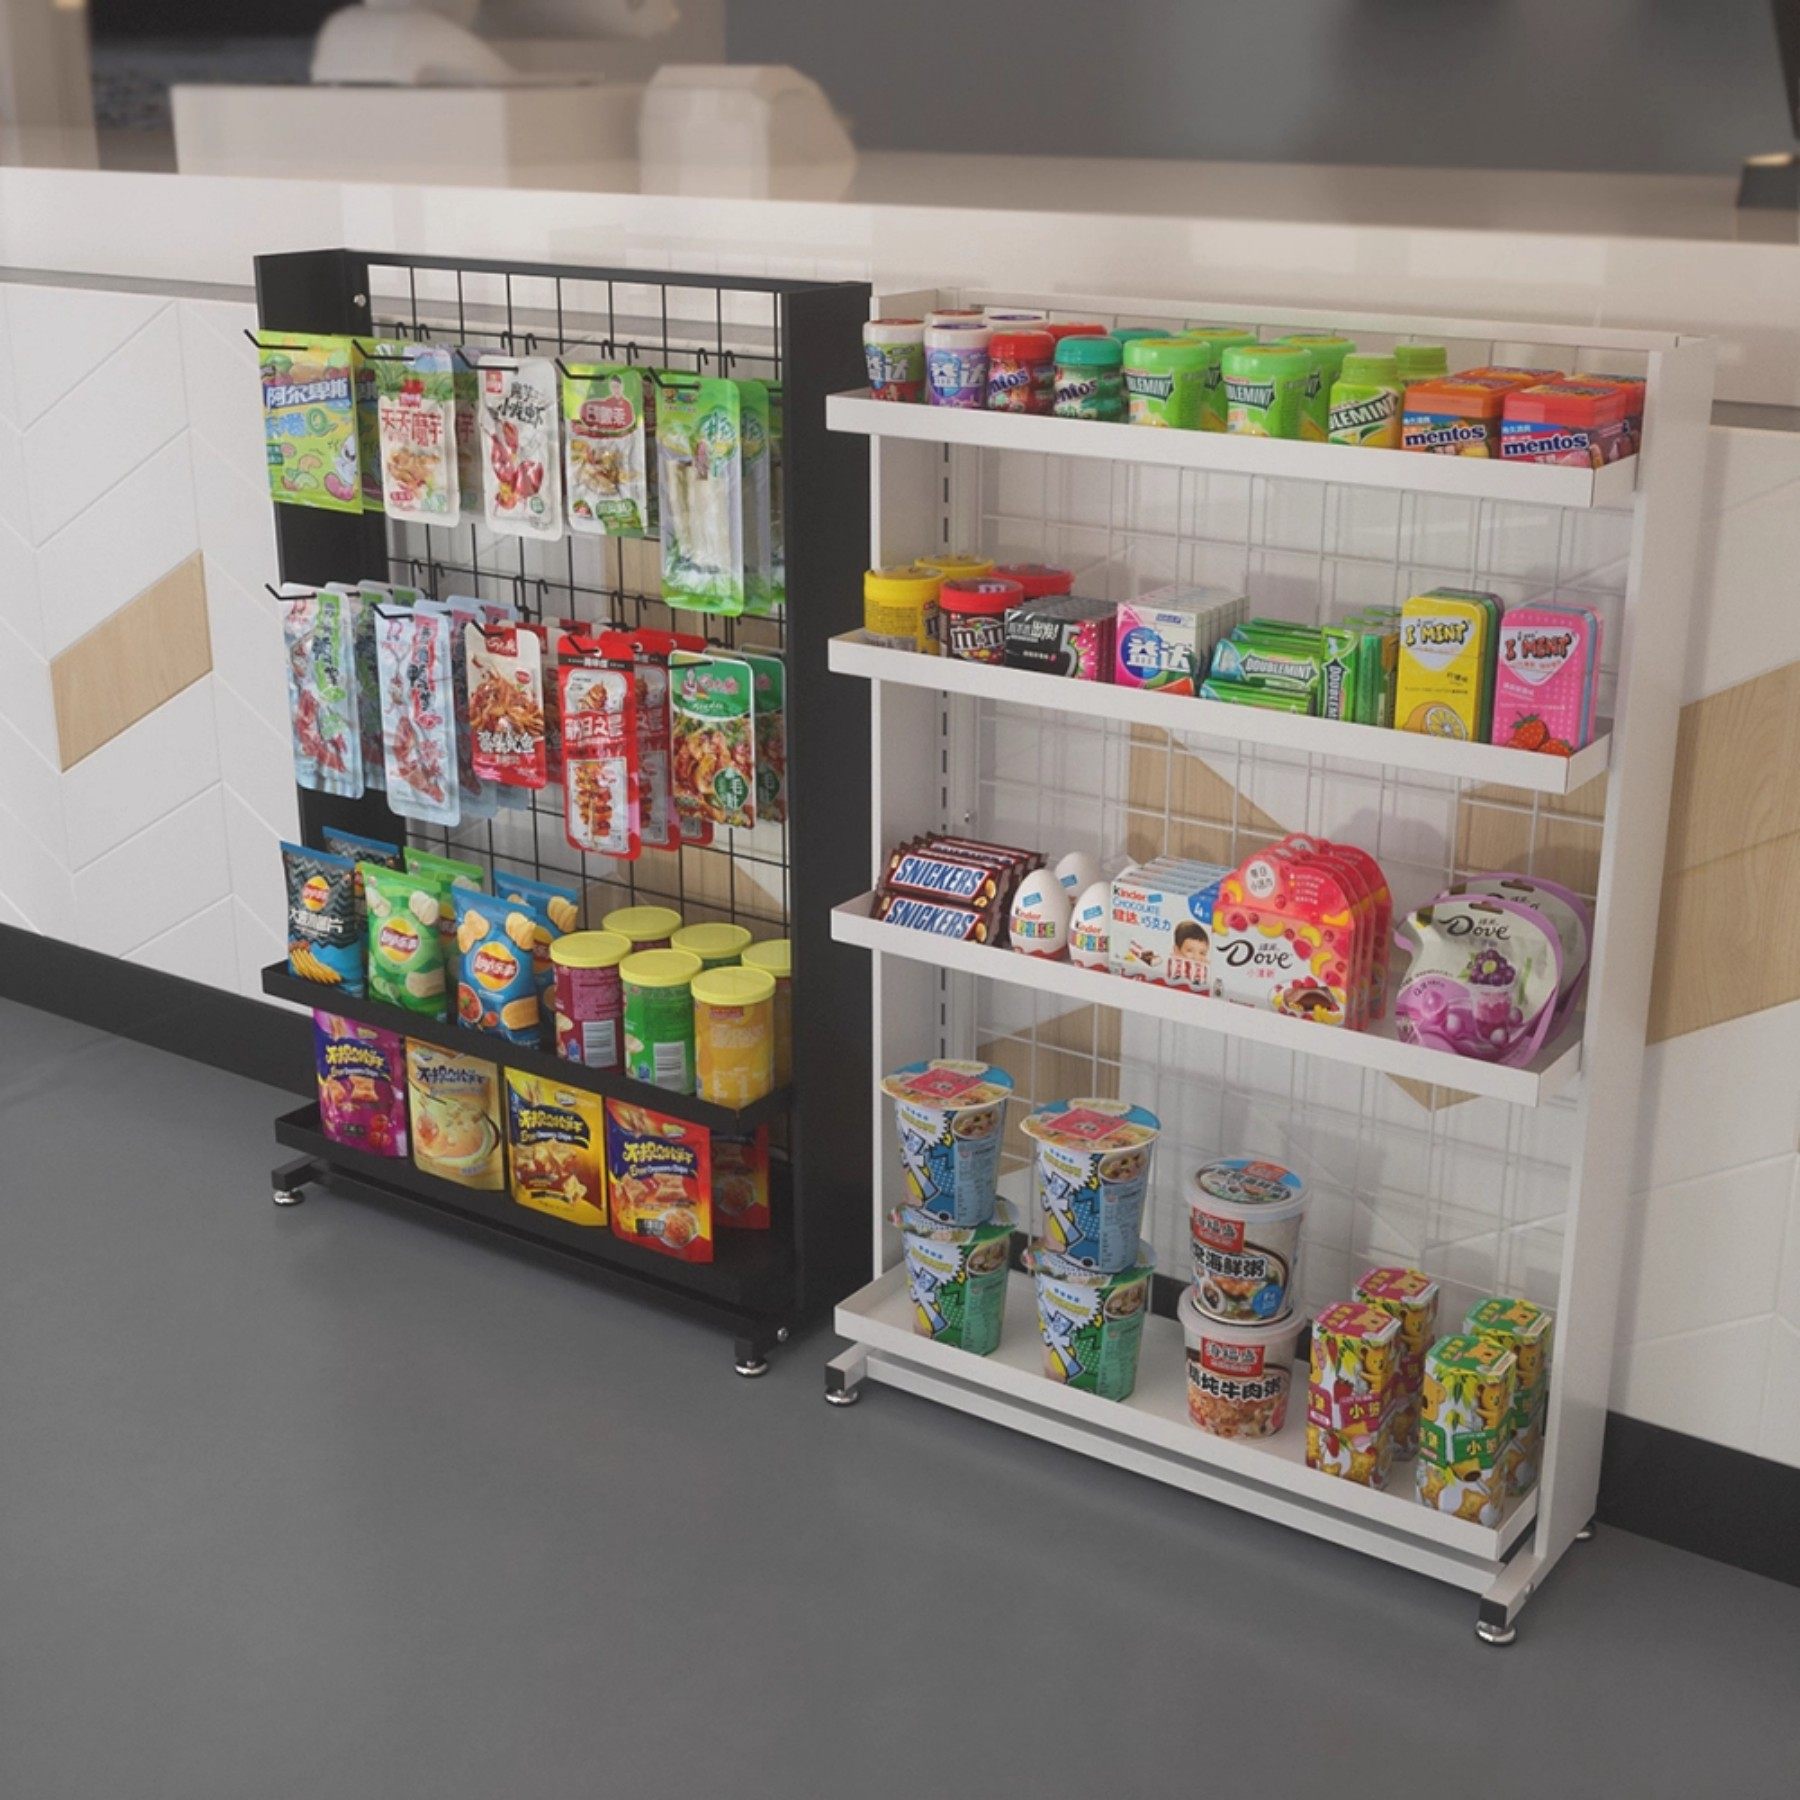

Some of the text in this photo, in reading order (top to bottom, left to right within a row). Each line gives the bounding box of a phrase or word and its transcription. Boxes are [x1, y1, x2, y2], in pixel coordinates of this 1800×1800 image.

[380, 409, 442, 447] 天天魔芋
[1404, 425, 1486, 447] mentos
[1503, 433, 1588, 456] mentos
[1060, 623, 1081, 678] 5
[1127, 636, 1193, 673] 益达
[1246, 656, 1313, 680] DOUBLEMINT
[895, 857, 984, 896] SNICKERS
[885, 898, 975, 939] SNICKERS
[1140, 914, 1171, 933] 巧克力
[1439, 915, 1511, 940] Dove
[1216, 939, 1293, 969] Dove
